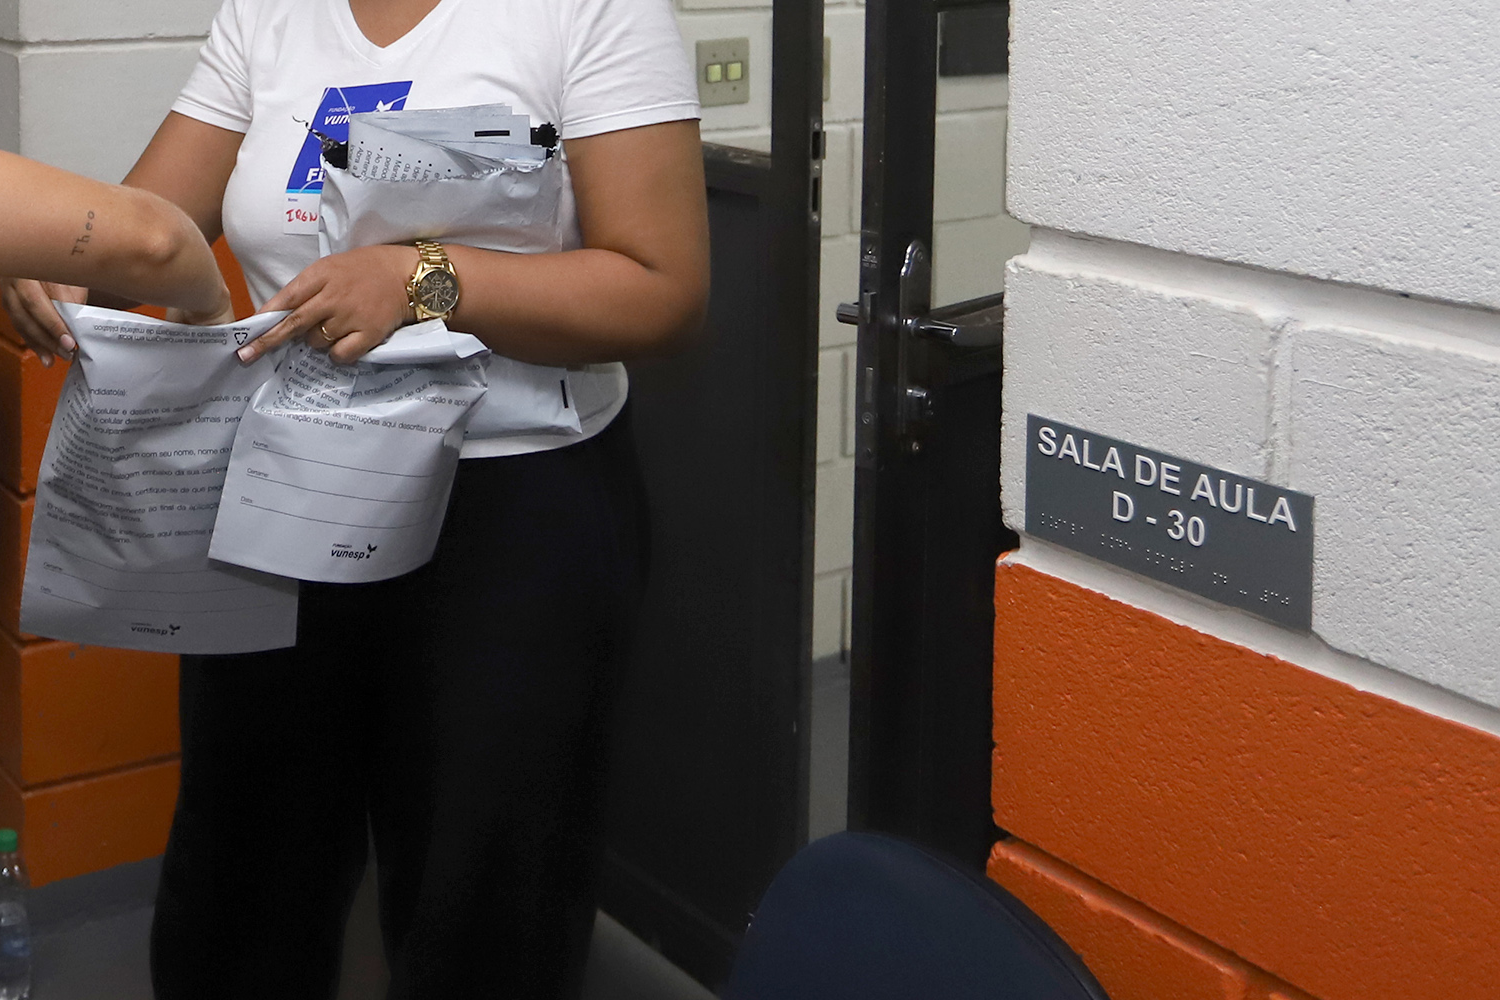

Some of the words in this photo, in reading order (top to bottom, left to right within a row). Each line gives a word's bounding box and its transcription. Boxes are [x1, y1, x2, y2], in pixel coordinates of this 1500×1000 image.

[324, 115, 351, 126] vun
[312, 417, 323, 426] do
[324, 420, 355, 431] certame.
[382, 420, 396, 428] aqui
[173, 449, 196, 457] nome,
[1037, 426, 1125, 479] SALA
[1135, 454, 1181, 495] DE
[1190, 473, 1297, 532] AULA
[1112, 490, 1134, 522] D
[1166, 509, 1205, 547] 30
[331, 549, 365, 561] vunesp
[131, 625, 168, 636] vunesp
